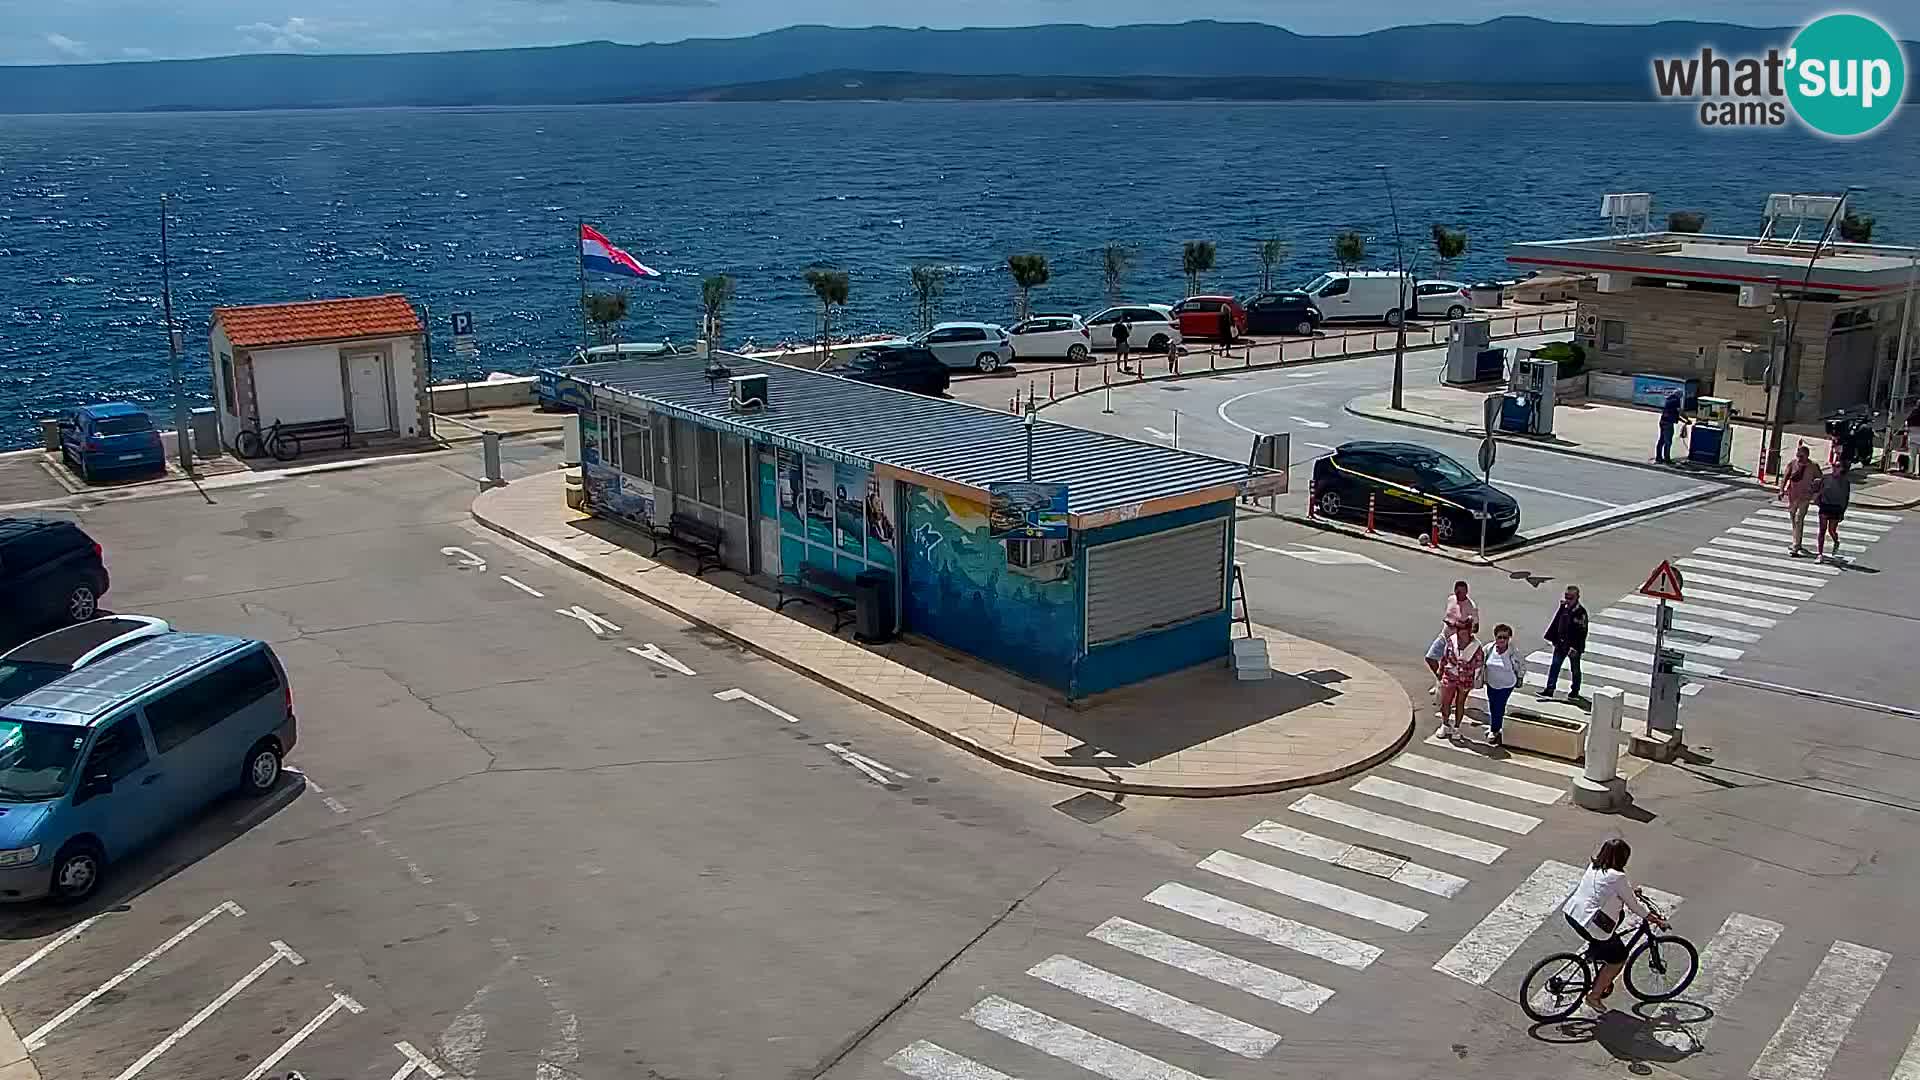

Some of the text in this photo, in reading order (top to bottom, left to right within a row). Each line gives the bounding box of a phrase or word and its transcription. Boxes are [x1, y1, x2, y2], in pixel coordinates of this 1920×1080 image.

[456, 316, 468, 332] P
[771, 436, 784, 449] BUS
[785, 440, 817, 456] STATION
[819, 447, 843, 462] TICKET
[844, 454, 871, 470] OFFICE
